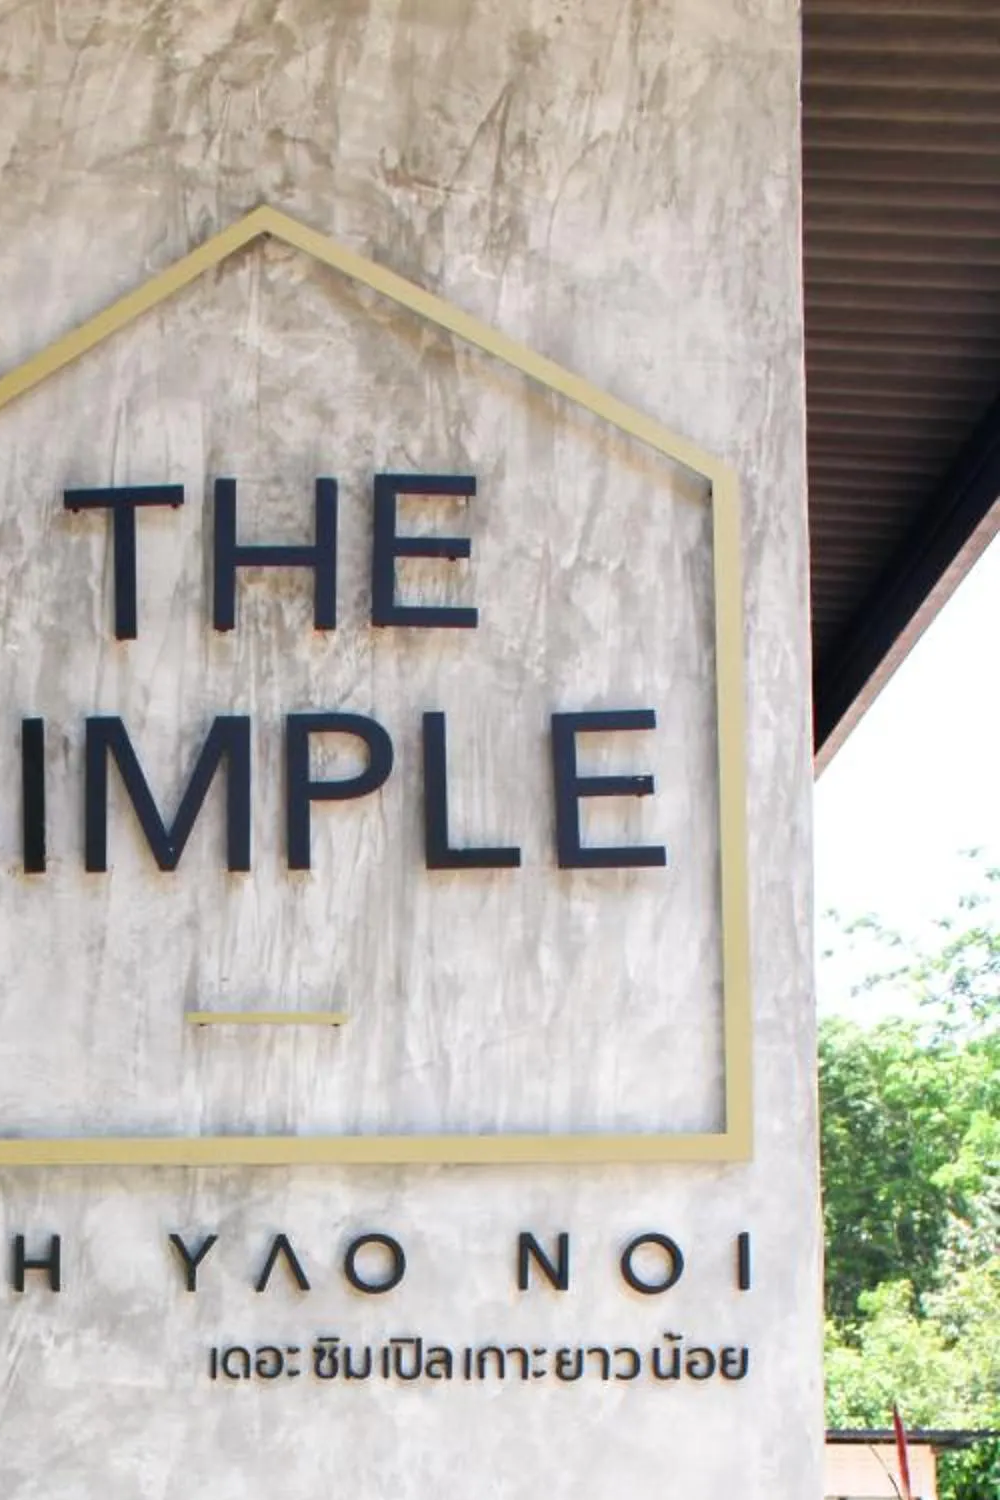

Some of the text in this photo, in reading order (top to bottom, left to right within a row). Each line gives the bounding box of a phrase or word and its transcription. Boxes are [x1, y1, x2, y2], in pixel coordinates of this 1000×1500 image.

[63, 474, 478, 640] THE
[170, 1232, 406, 1294] YAO
[518, 1232, 750, 1294] NOI
